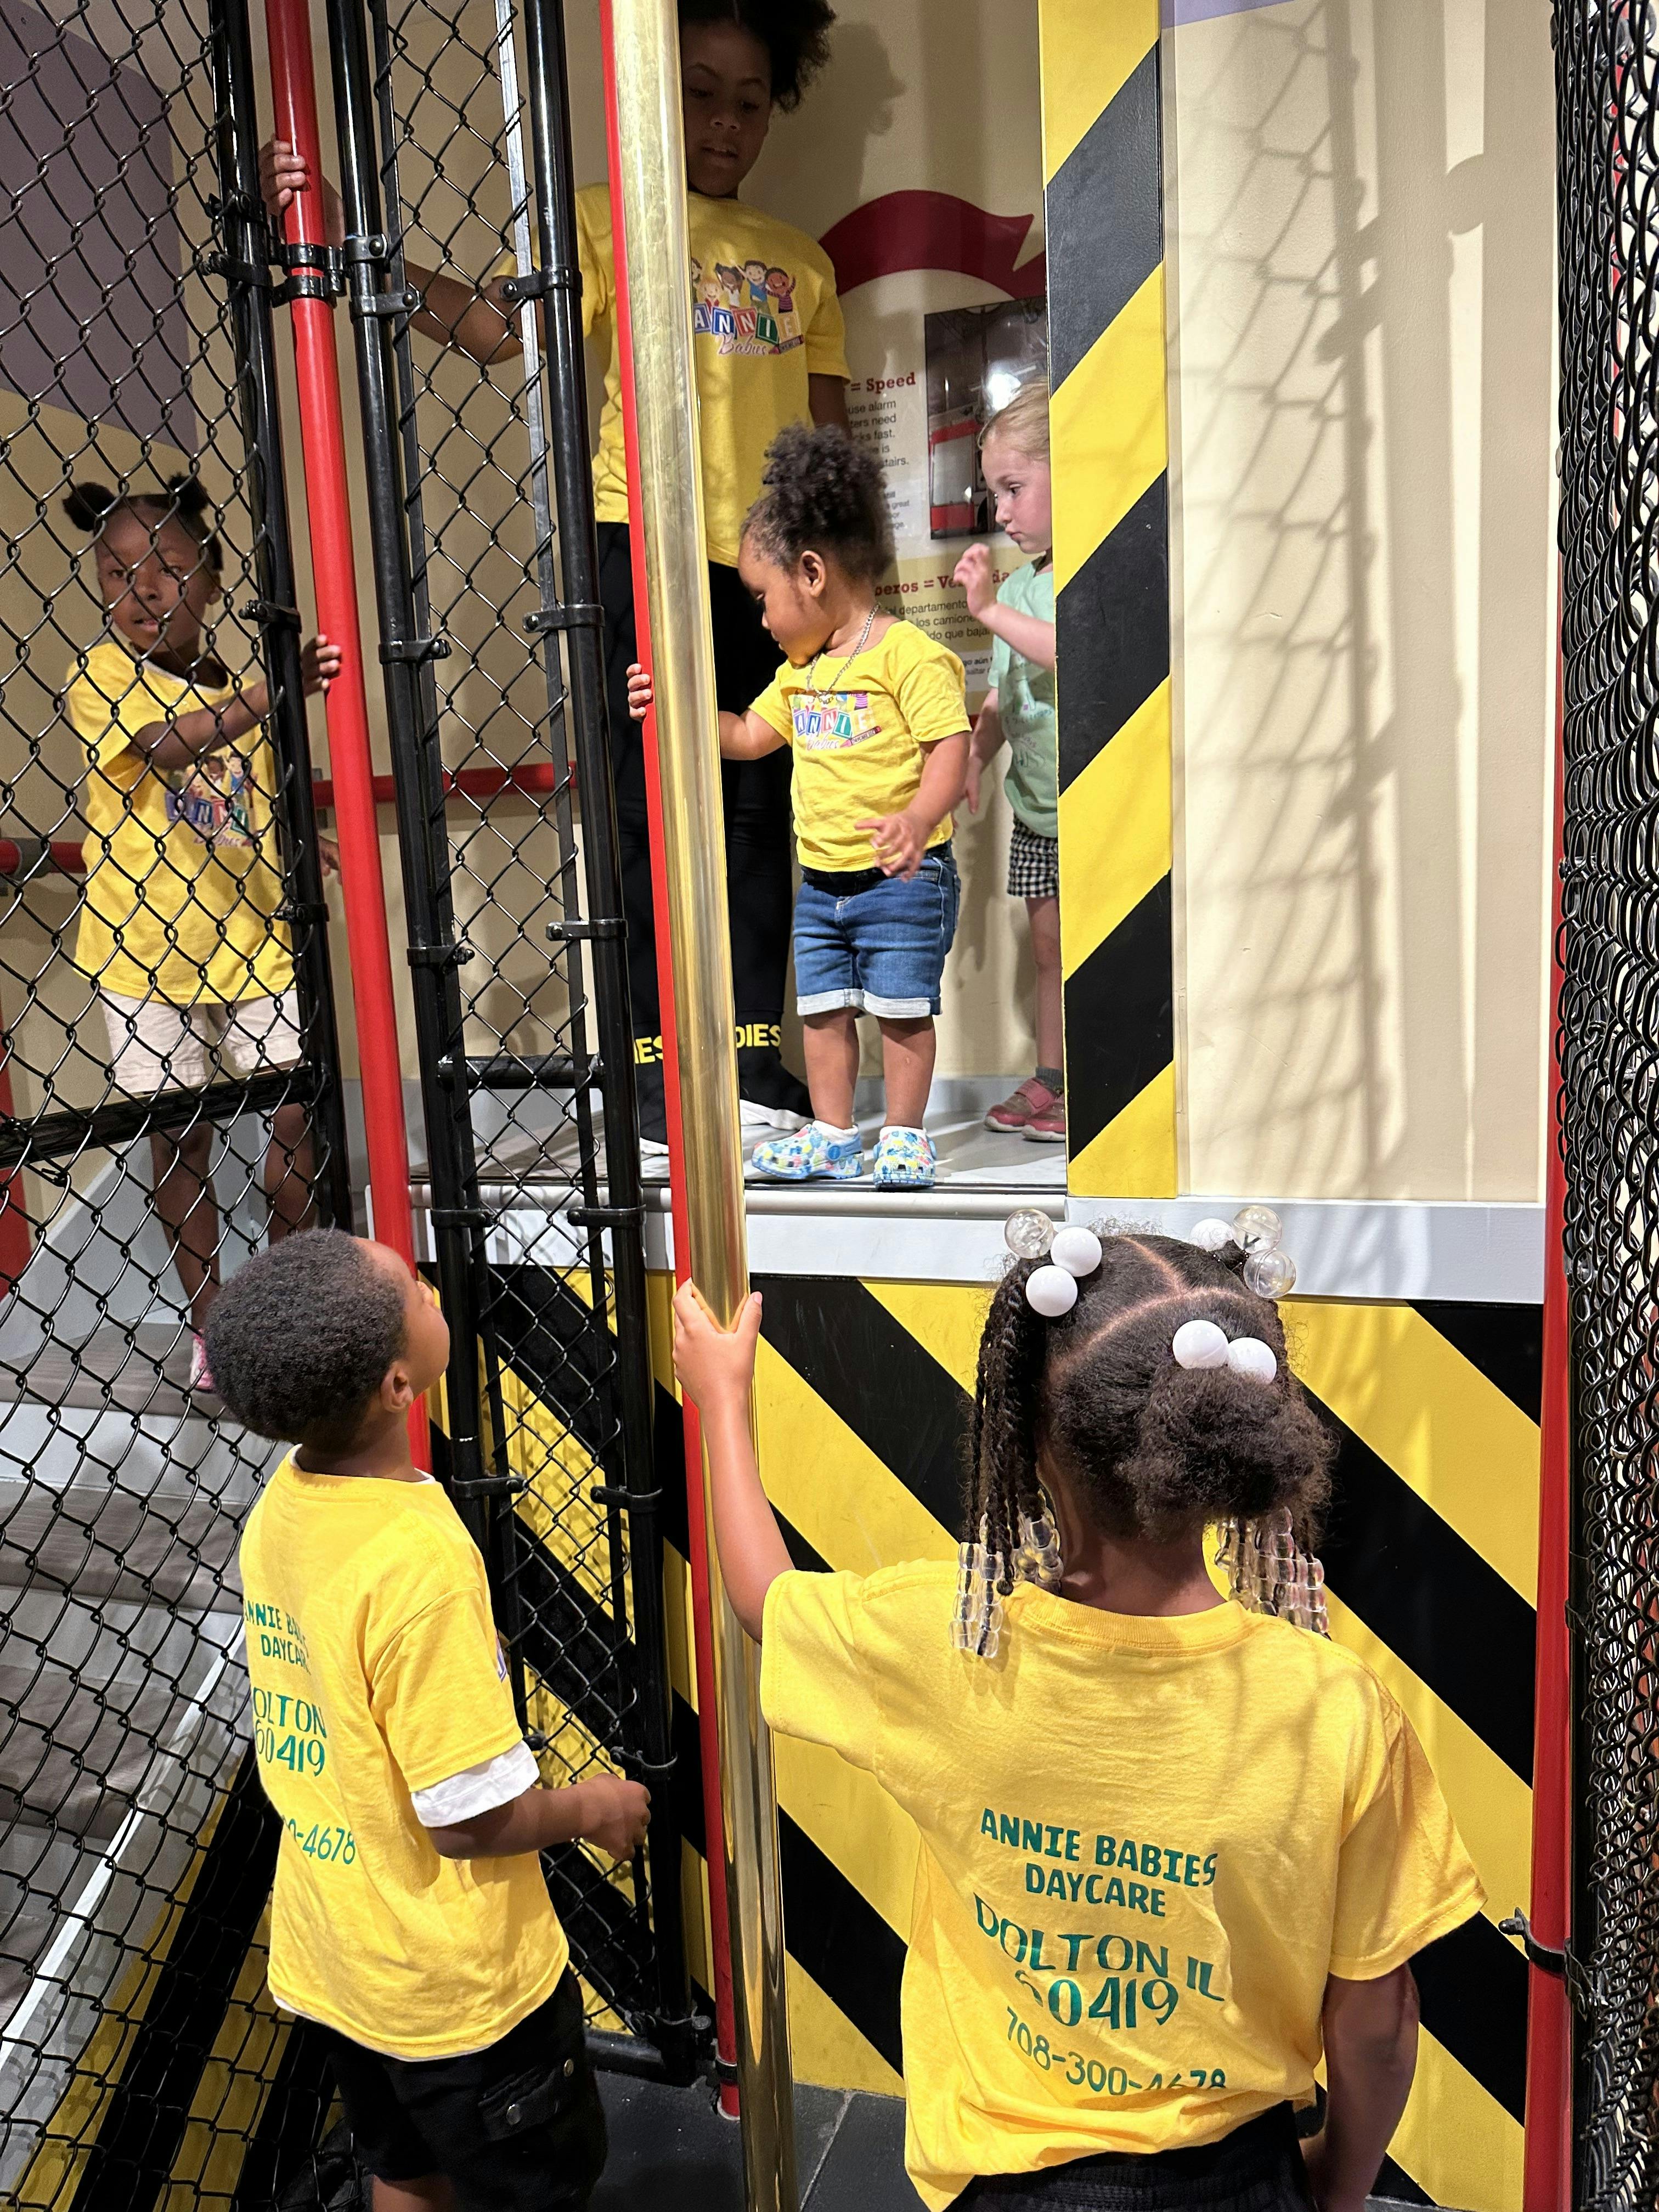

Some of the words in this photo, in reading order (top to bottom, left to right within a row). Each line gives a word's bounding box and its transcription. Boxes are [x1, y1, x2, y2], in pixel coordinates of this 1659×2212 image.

[694, 306, 797, 341] ANNIE
[866, 371, 916, 394] Speed
[868, 400, 896, 412] alarm
[872, 413, 896, 425] need
[933, 613, 977, 625] camione
[945, 630, 963, 640] que
[795, 710, 870, 737] ANNIE
[255, 1719, 325, 1777] 60419
[980, 1808, 1080, 1861] ANNIE
[1095, 1835, 1218, 1887] BABIES
[1025, 1863, 1166, 1917] DAYCARE
[973, 1892, 1169, 1978] DOLTON
[1187, 1956, 1225, 2001] IL
